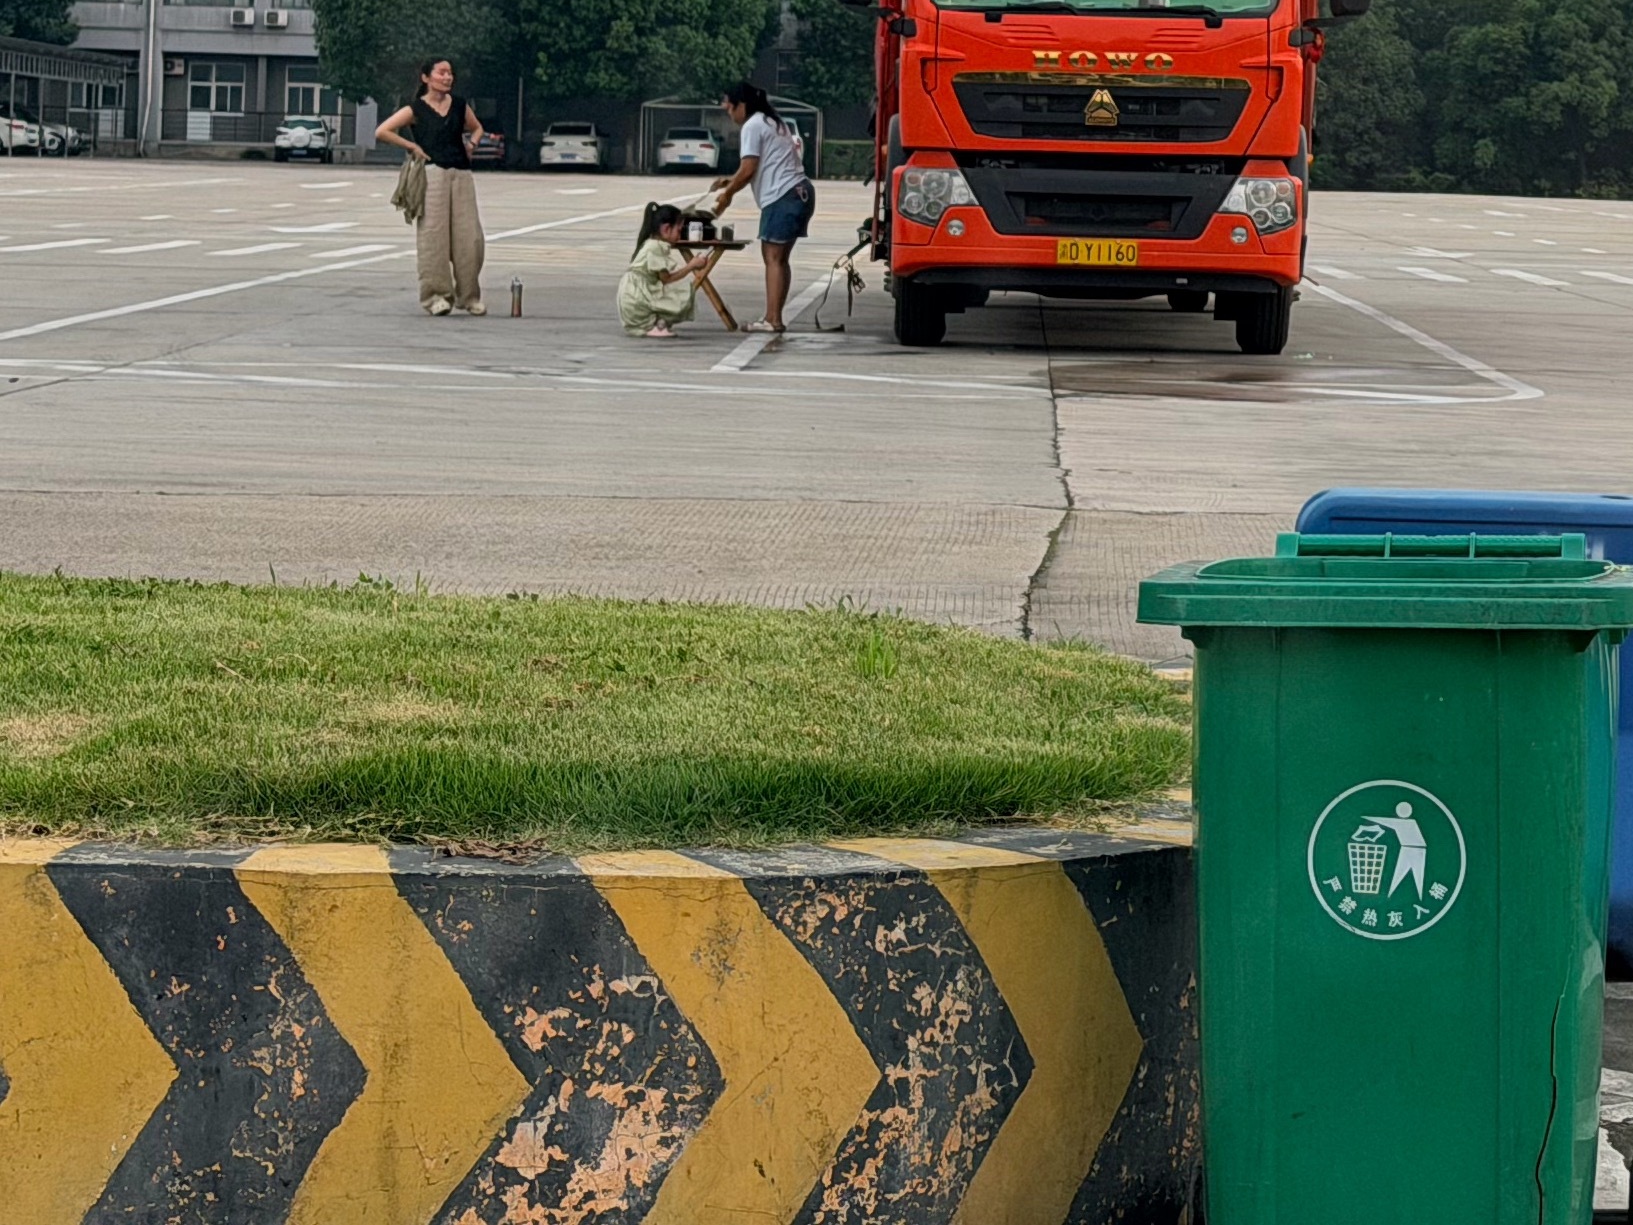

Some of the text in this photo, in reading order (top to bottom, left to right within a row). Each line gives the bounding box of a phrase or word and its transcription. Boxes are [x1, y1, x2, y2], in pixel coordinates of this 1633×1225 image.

[1031, 50, 1174, 71] HOWO
[1322, 876, 1449, 928] 严禁热灰入桶
